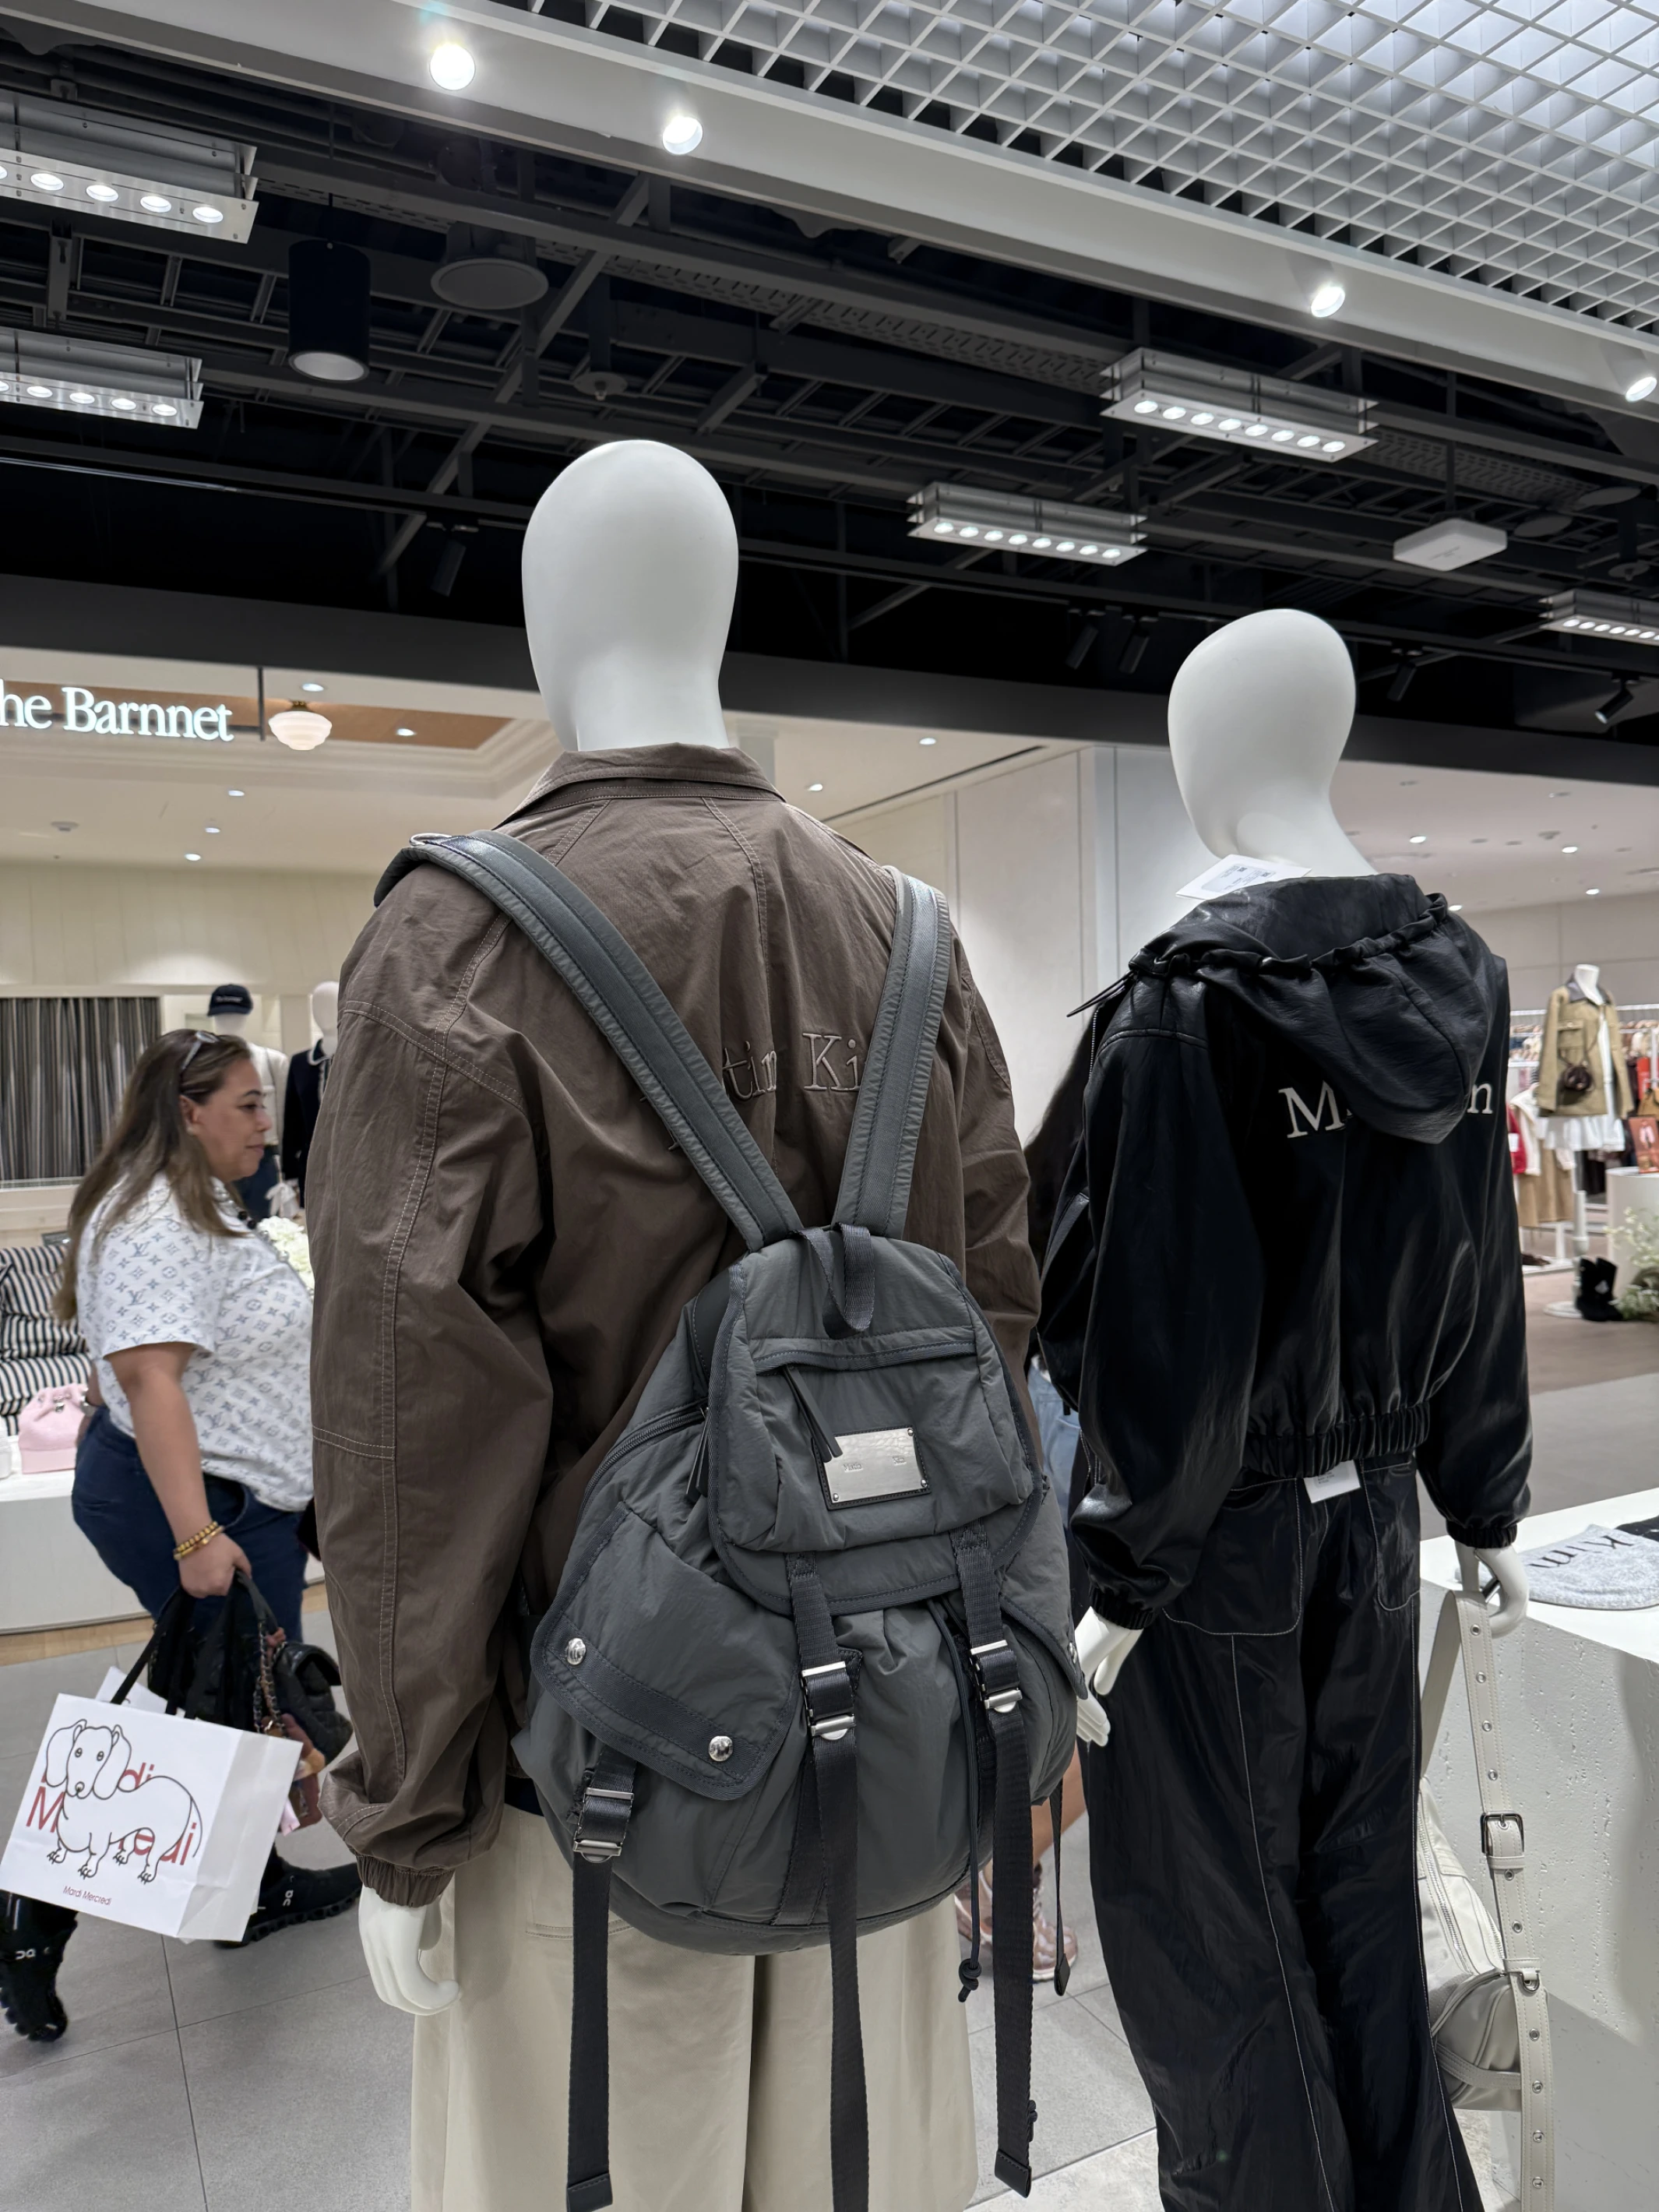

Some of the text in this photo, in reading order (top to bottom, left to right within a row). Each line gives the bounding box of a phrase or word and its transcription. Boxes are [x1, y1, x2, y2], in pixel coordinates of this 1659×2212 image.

[0, 678, 234, 741] he Barnnet
[802, 1033, 860, 1091] Ki
